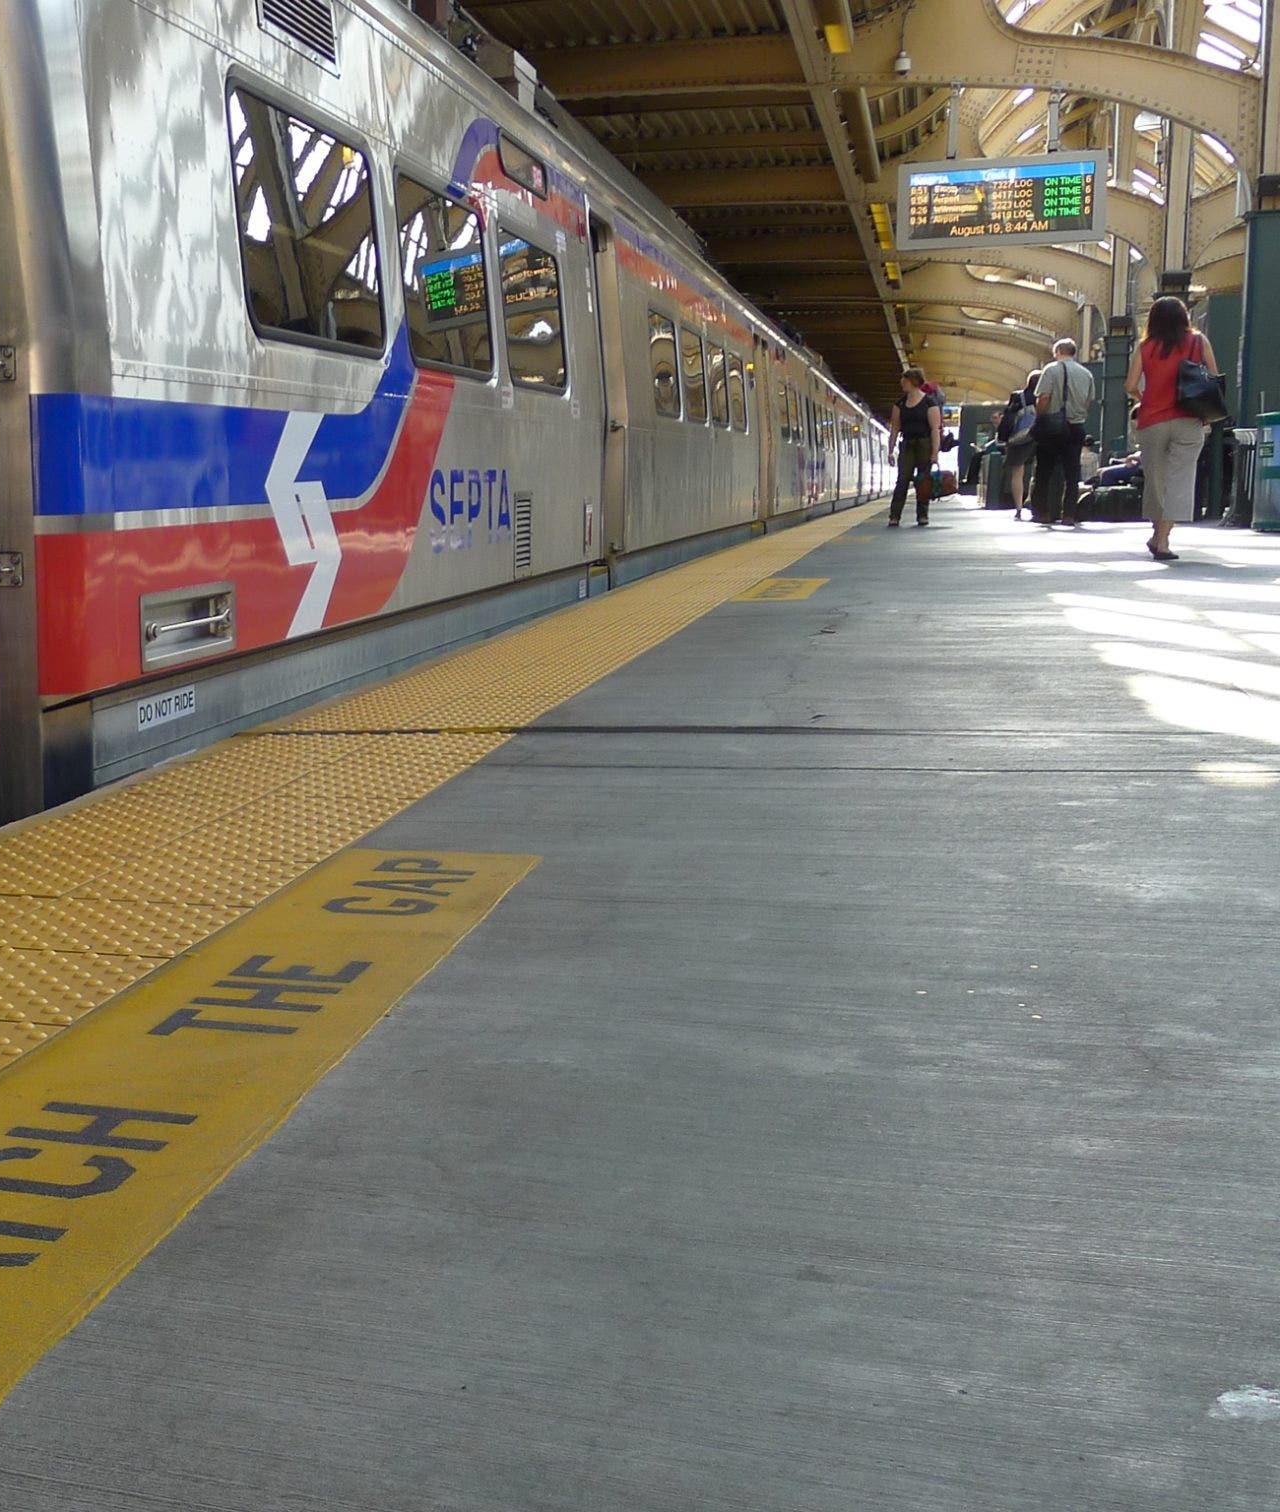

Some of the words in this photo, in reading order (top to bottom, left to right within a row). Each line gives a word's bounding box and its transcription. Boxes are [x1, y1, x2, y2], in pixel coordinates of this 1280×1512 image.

[1014, 179, 1034, 188] LOC
[1044, 177, 1058, 186] ON
[1060, 176, 1082, 184] TIME
[1085, 175, 1092, 183] 6
[933, 194, 960, 204] Airport
[1014, 189, 1034, 198] LOC
[1044, 187, 1058, 197] ON
[1059, 186, 1082, 195] TIME
[1085, 185, 1091, 194] 6
[1013, 199, 1033, 208] LOC
[1043, 198, 1058, 207] ON
[1059, 197, 1081, 206] TIME
[1084, 196, 1091, 205] 6
[933, 215, 960, 224] Airport
[1013, 210, 1033, 218] LOC
[1043, 208, 1057, 217] ON
[1058, 207, 1080, 216] TIME
[950, 224, 985, 237] August
[1005, 221, 1028, 233] 8:44
[1030, 220, 1049, 232] AM
[430, 468, 511, 548] SEPTA
[139, 704, 153, 724] DO
[155, 697, 172, 719] NOT
[174, 691, 194, 712] RIDE
[148, 954, 374, 1037] THE
[323, 857, 477, 917] GAP
